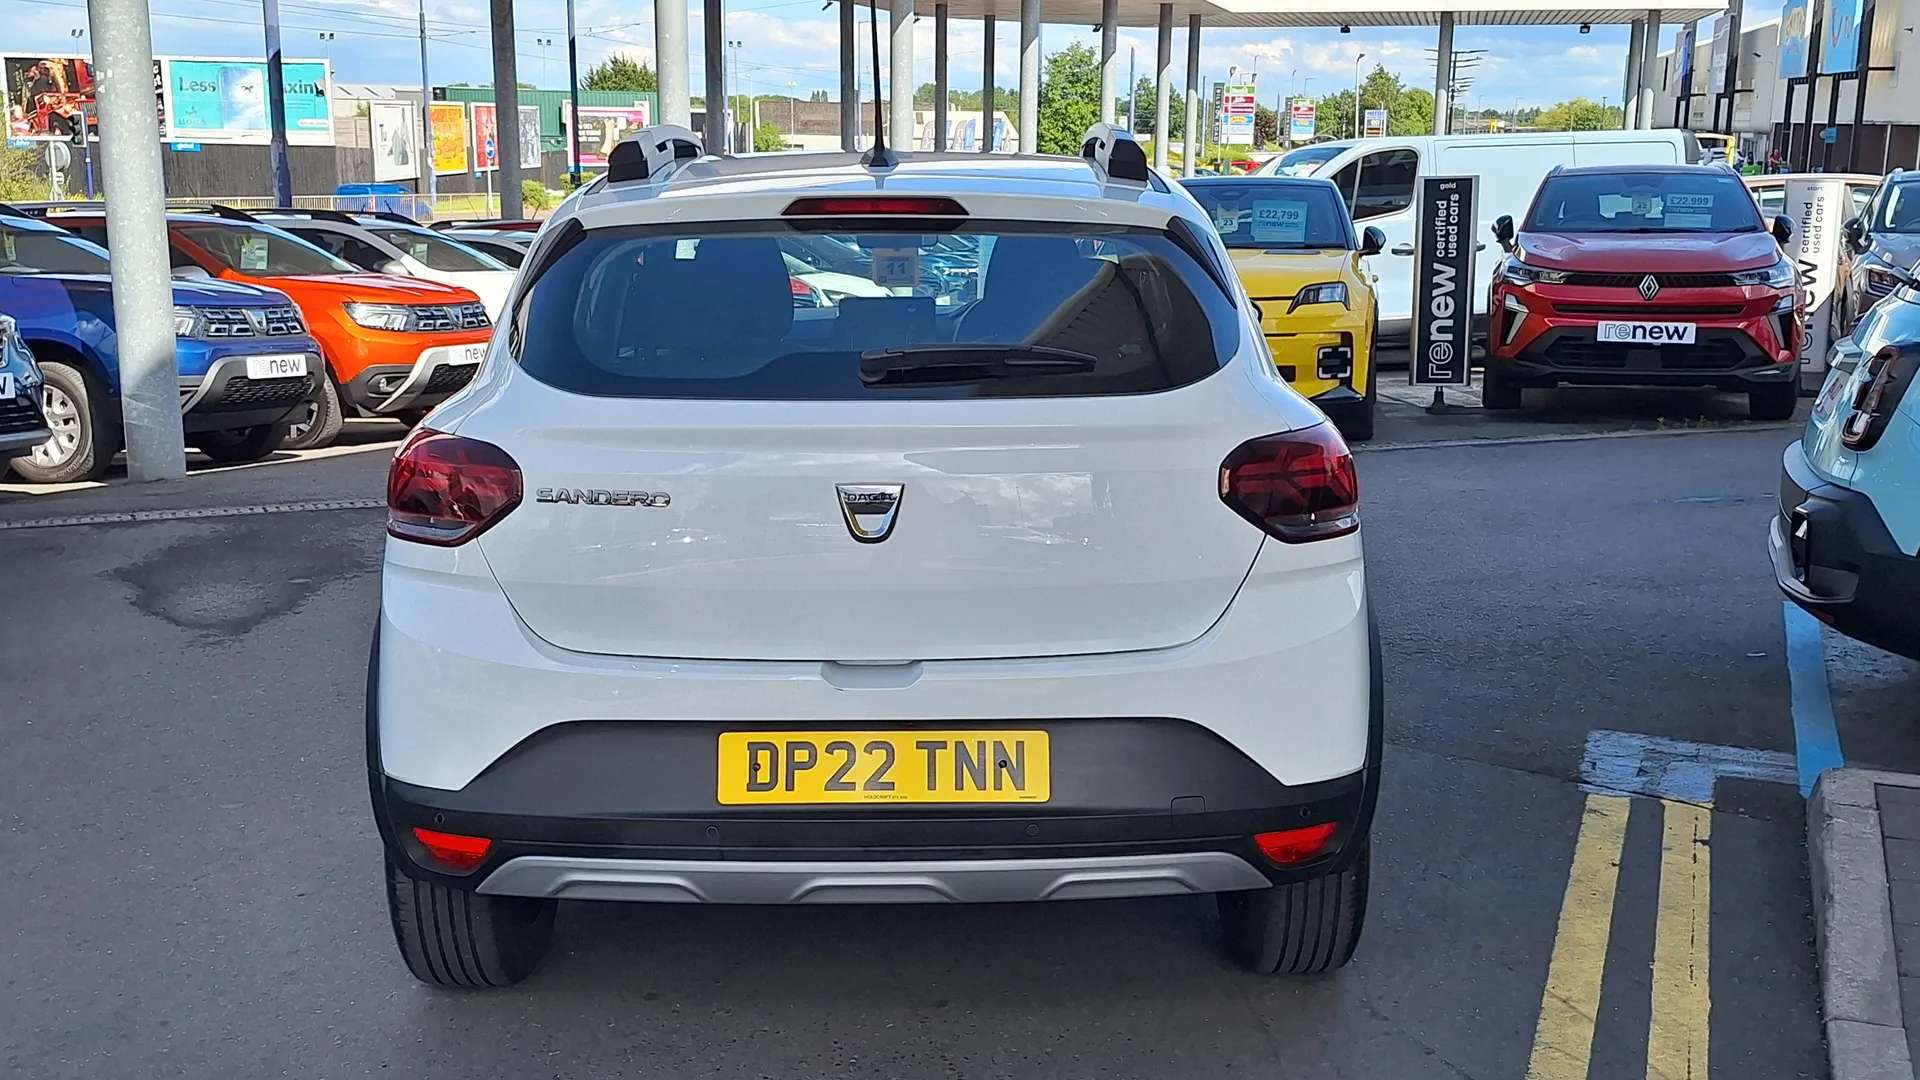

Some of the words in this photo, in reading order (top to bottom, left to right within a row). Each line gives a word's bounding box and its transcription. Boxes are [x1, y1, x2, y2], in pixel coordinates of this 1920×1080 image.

[179, 76, 217, 93] Less
[1439, 182, 1457, 191] gold
[1259, 209, 1299, 221] £22,799
[1449, 193, 1460, 224] cars
[1815, 195, 1825, 223] cars
[1435, 200, 1448, 258] certified
[1447, 225, 1459, 258] used
[1800, 201, 1813, 254] certified
[1812, 224, 1823, 254] used
[1427, 262, 1457, 379] renew
[1603, 323, 1688, 341] renew
[536, 488, 671, 508] SANDERO
[746, 740, 897, 792] DP22
[916, 740, 1027, 791] TNN
